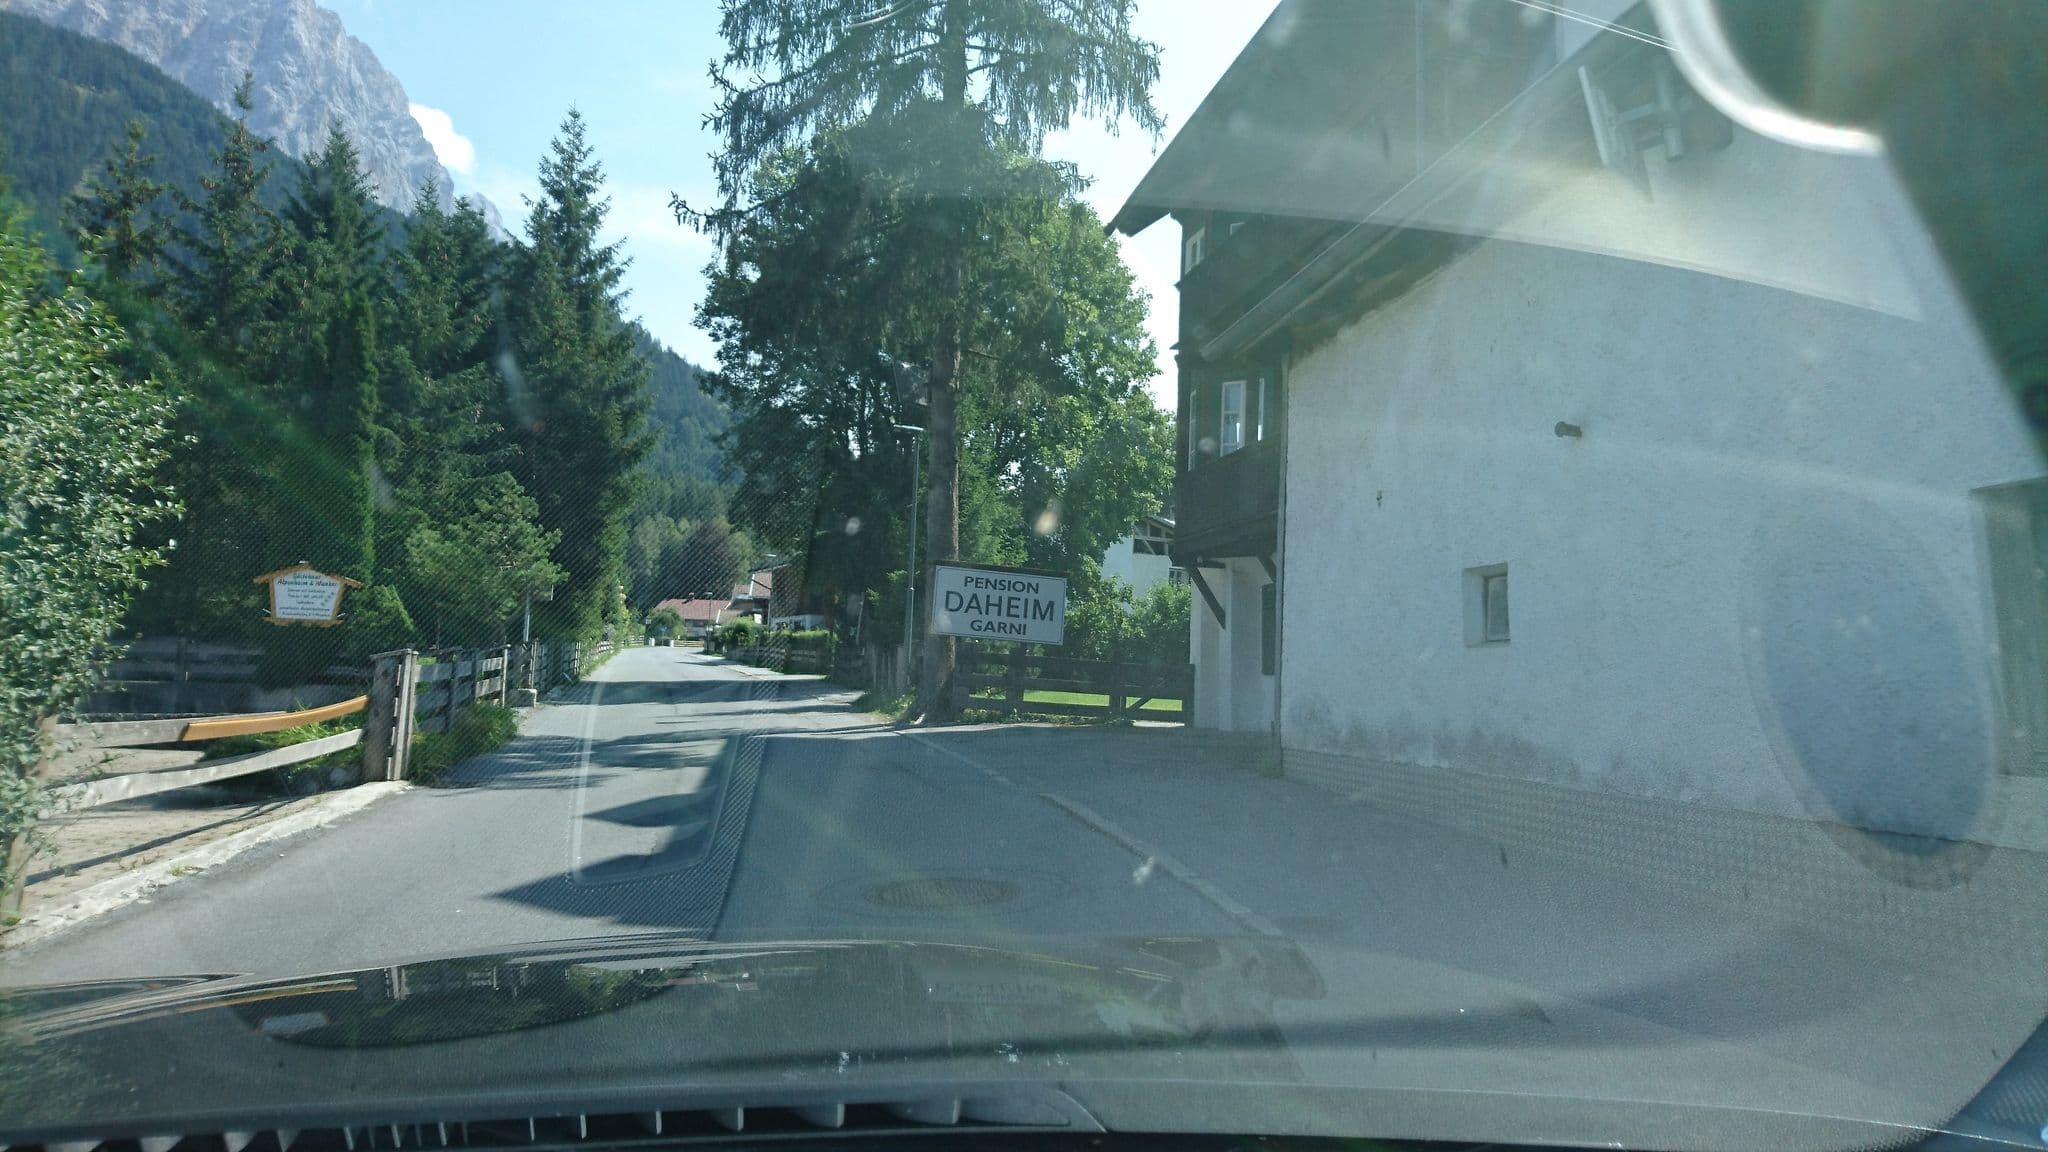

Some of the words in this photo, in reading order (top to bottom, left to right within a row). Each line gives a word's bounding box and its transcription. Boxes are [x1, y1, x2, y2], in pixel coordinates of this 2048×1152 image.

[964, 576, 1039, 594] PENSION
[945, 591, 1055, 621] DAHEIM
[970, 620, 1027, 635] GARNI
